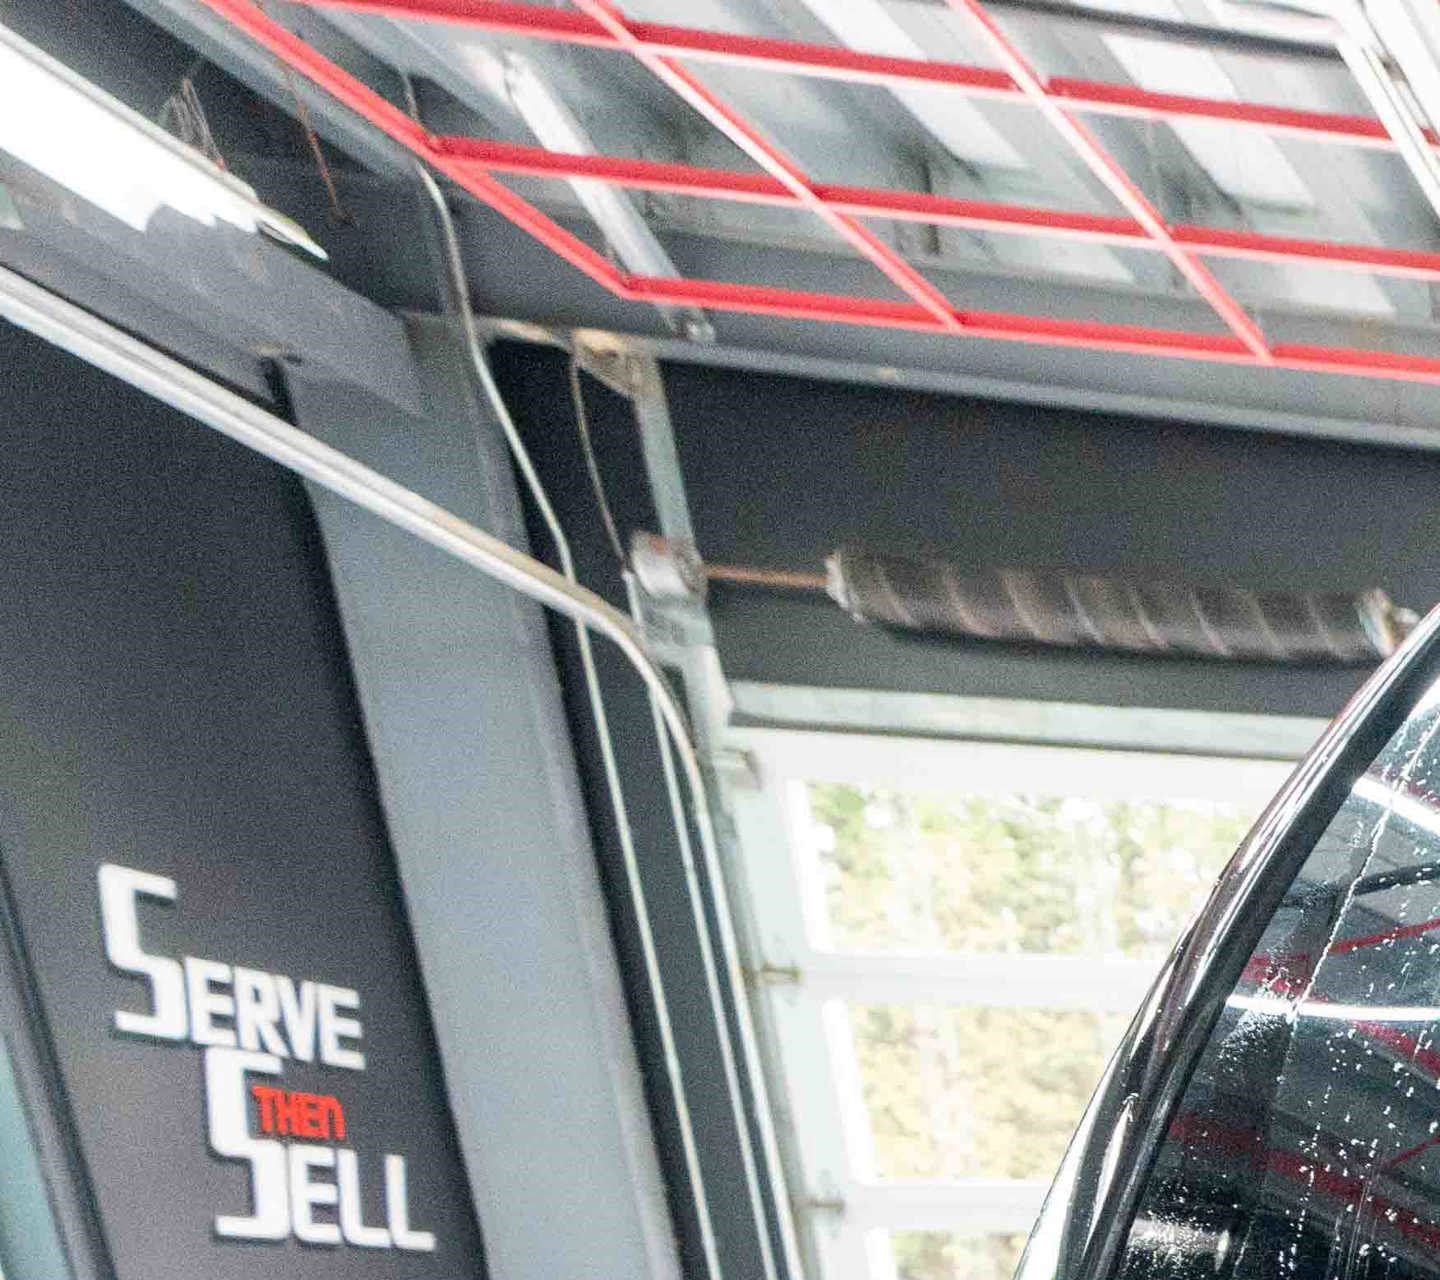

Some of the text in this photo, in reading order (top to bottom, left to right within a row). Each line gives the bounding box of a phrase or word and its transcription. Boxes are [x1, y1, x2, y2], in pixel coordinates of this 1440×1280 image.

[98, 862, 366, 1070] SERVE
[205, 1046, 436, 1252] SELL
[252, 1085, 346, 1141] THEN
